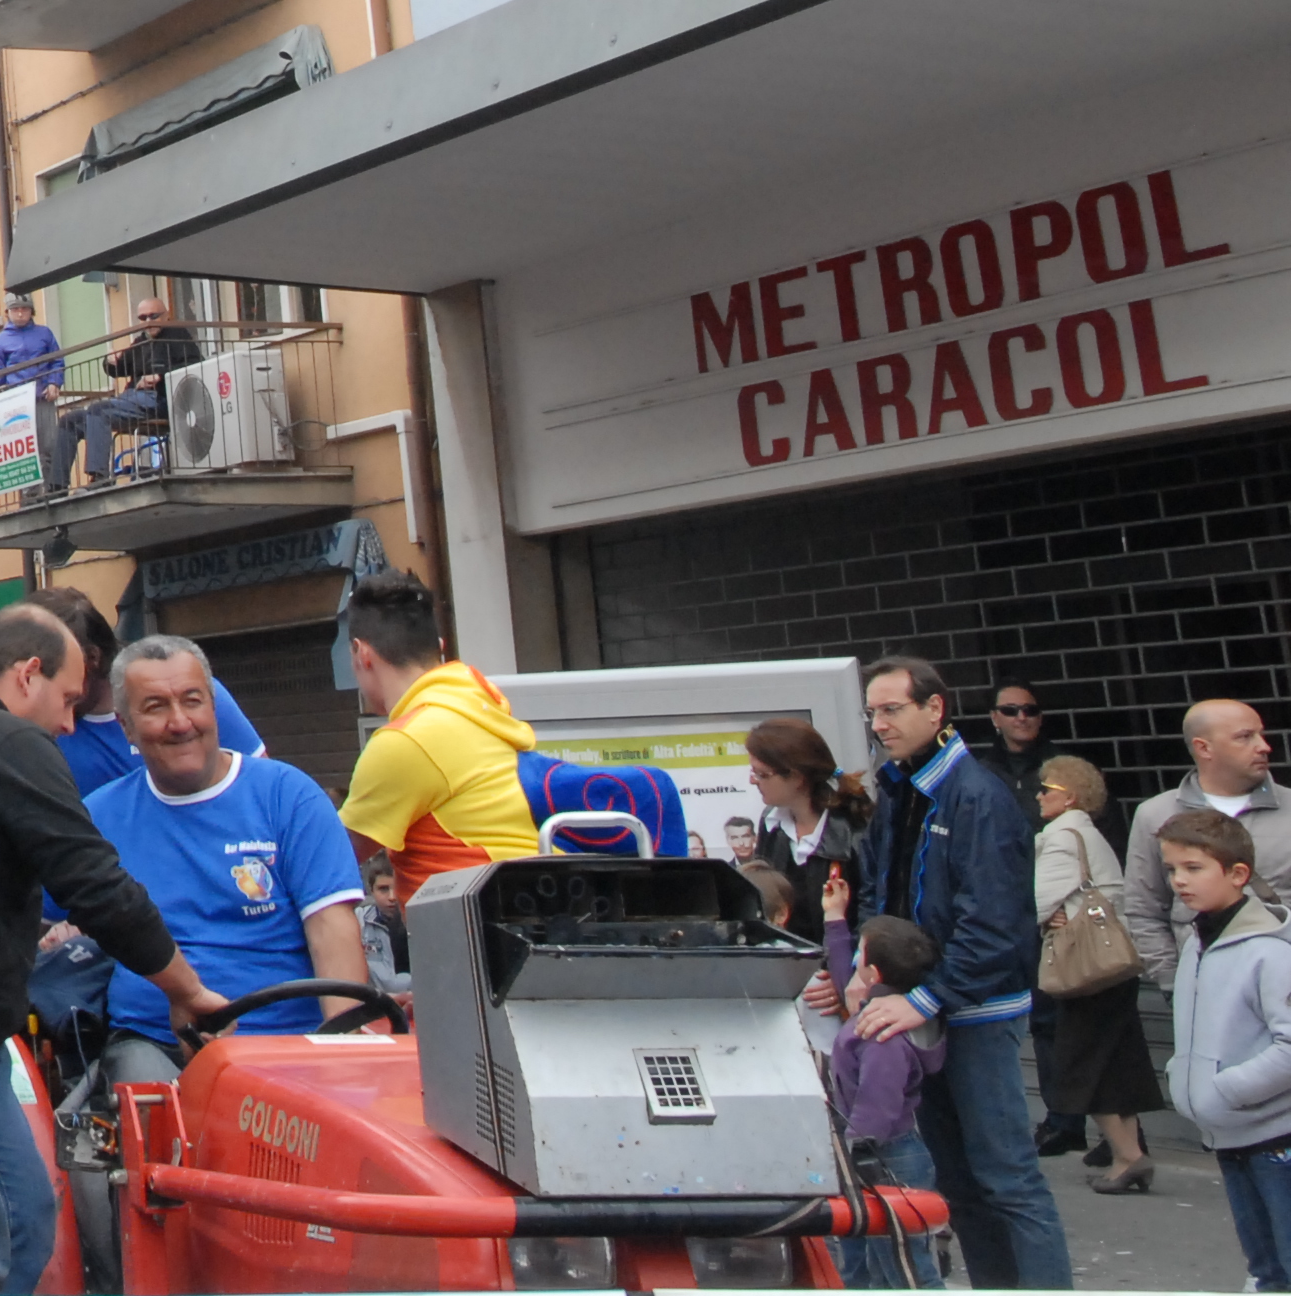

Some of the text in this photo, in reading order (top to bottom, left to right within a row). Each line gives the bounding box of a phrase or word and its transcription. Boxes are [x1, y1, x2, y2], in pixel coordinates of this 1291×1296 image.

[691, 169, 1231, 373] METROPOL
[736, 298, 1210, 468] CARACOL
[148, 526, 344, 587] SALONE CRISTIAN
[680, 786, 691, 795] di
[241, 902, 277, 917] Turbo
[238, 1094, 321, 1163] GOLDONI
